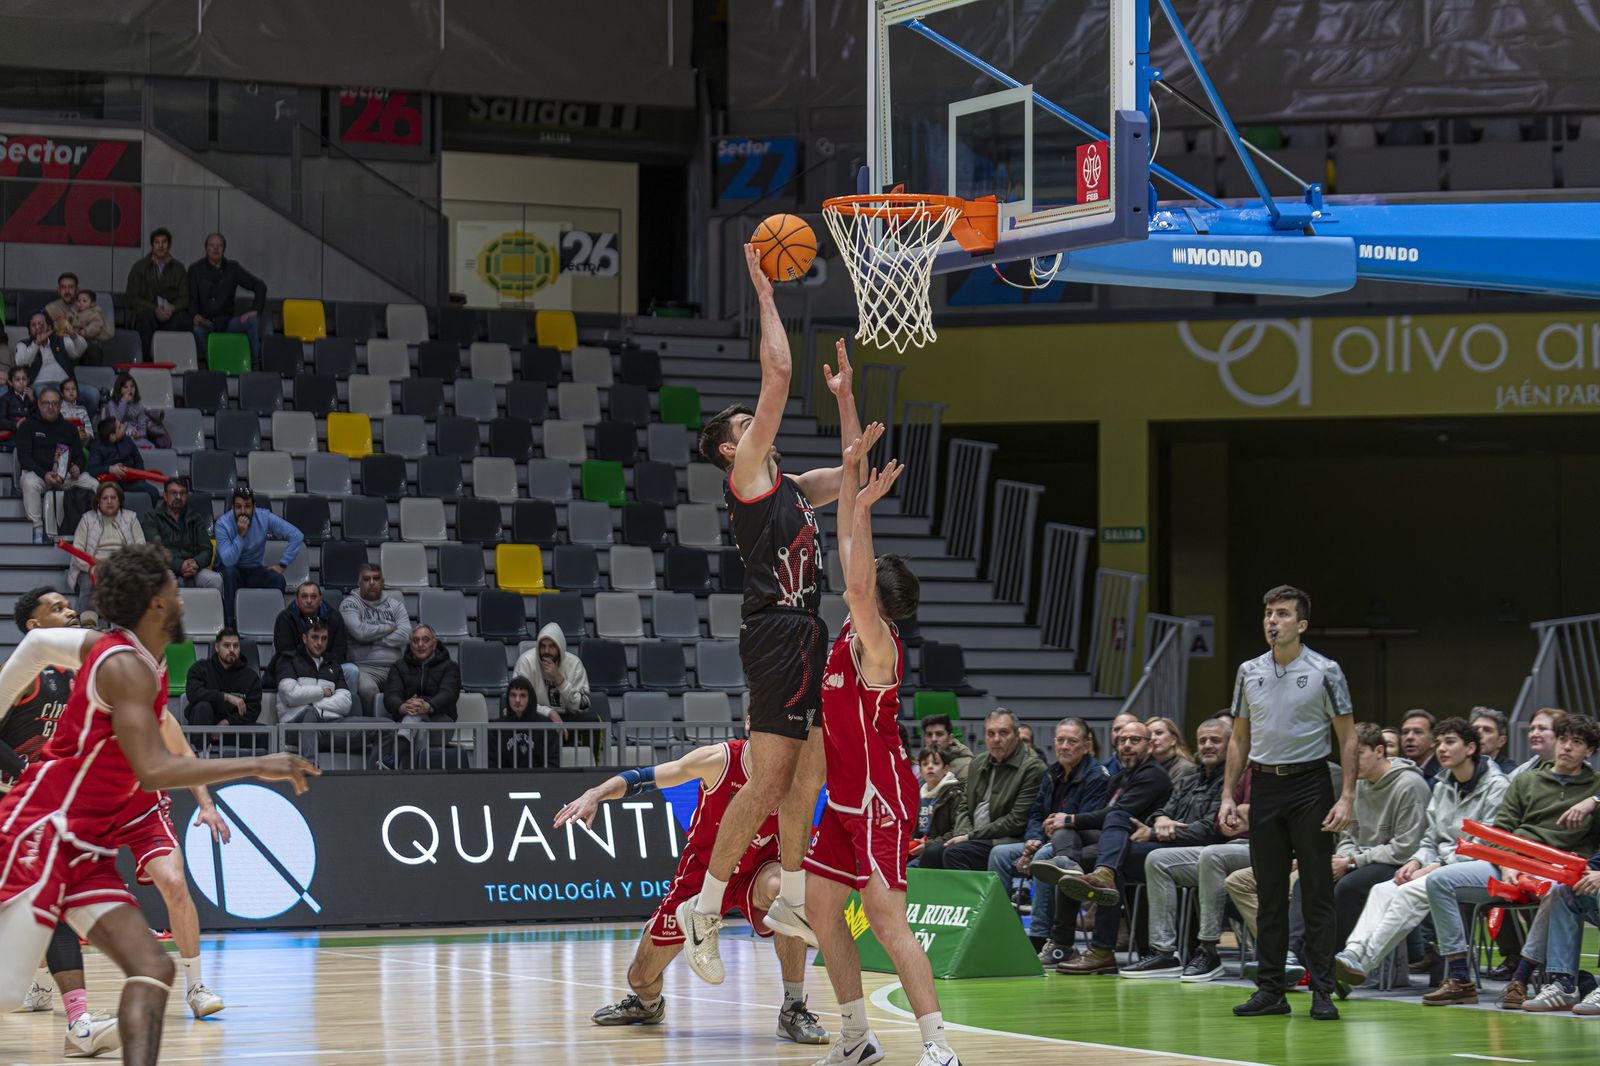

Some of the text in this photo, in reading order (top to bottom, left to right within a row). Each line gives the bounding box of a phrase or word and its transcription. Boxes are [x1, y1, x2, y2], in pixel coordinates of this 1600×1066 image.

[339, 90, 422, 145] 26
[0, 134, 87, 165] Sector
[718, 139, 772, 157] Sector
[719, 137, 798, 200] 27
[0, 136, 142, 247] 26
[562, 231, 619, 278] 26
[1187, 247, 1262, 268] MONDO
[1359, 244, 1419, 262] MONDO
[1332, 316, 1508, 374] olivo
[1495, 379, 1552, 410] JAÉN
[1104, 529, 1142, 541] SALIDA
[381, 791, 680, 865] QUĀNTI
[484, 879, 616, 902] TECNOLOGÍA
[620, 881, 633, 898] Y
[662, 913, 677, 929] 15
[919, 904, 971, 927] RURAL
